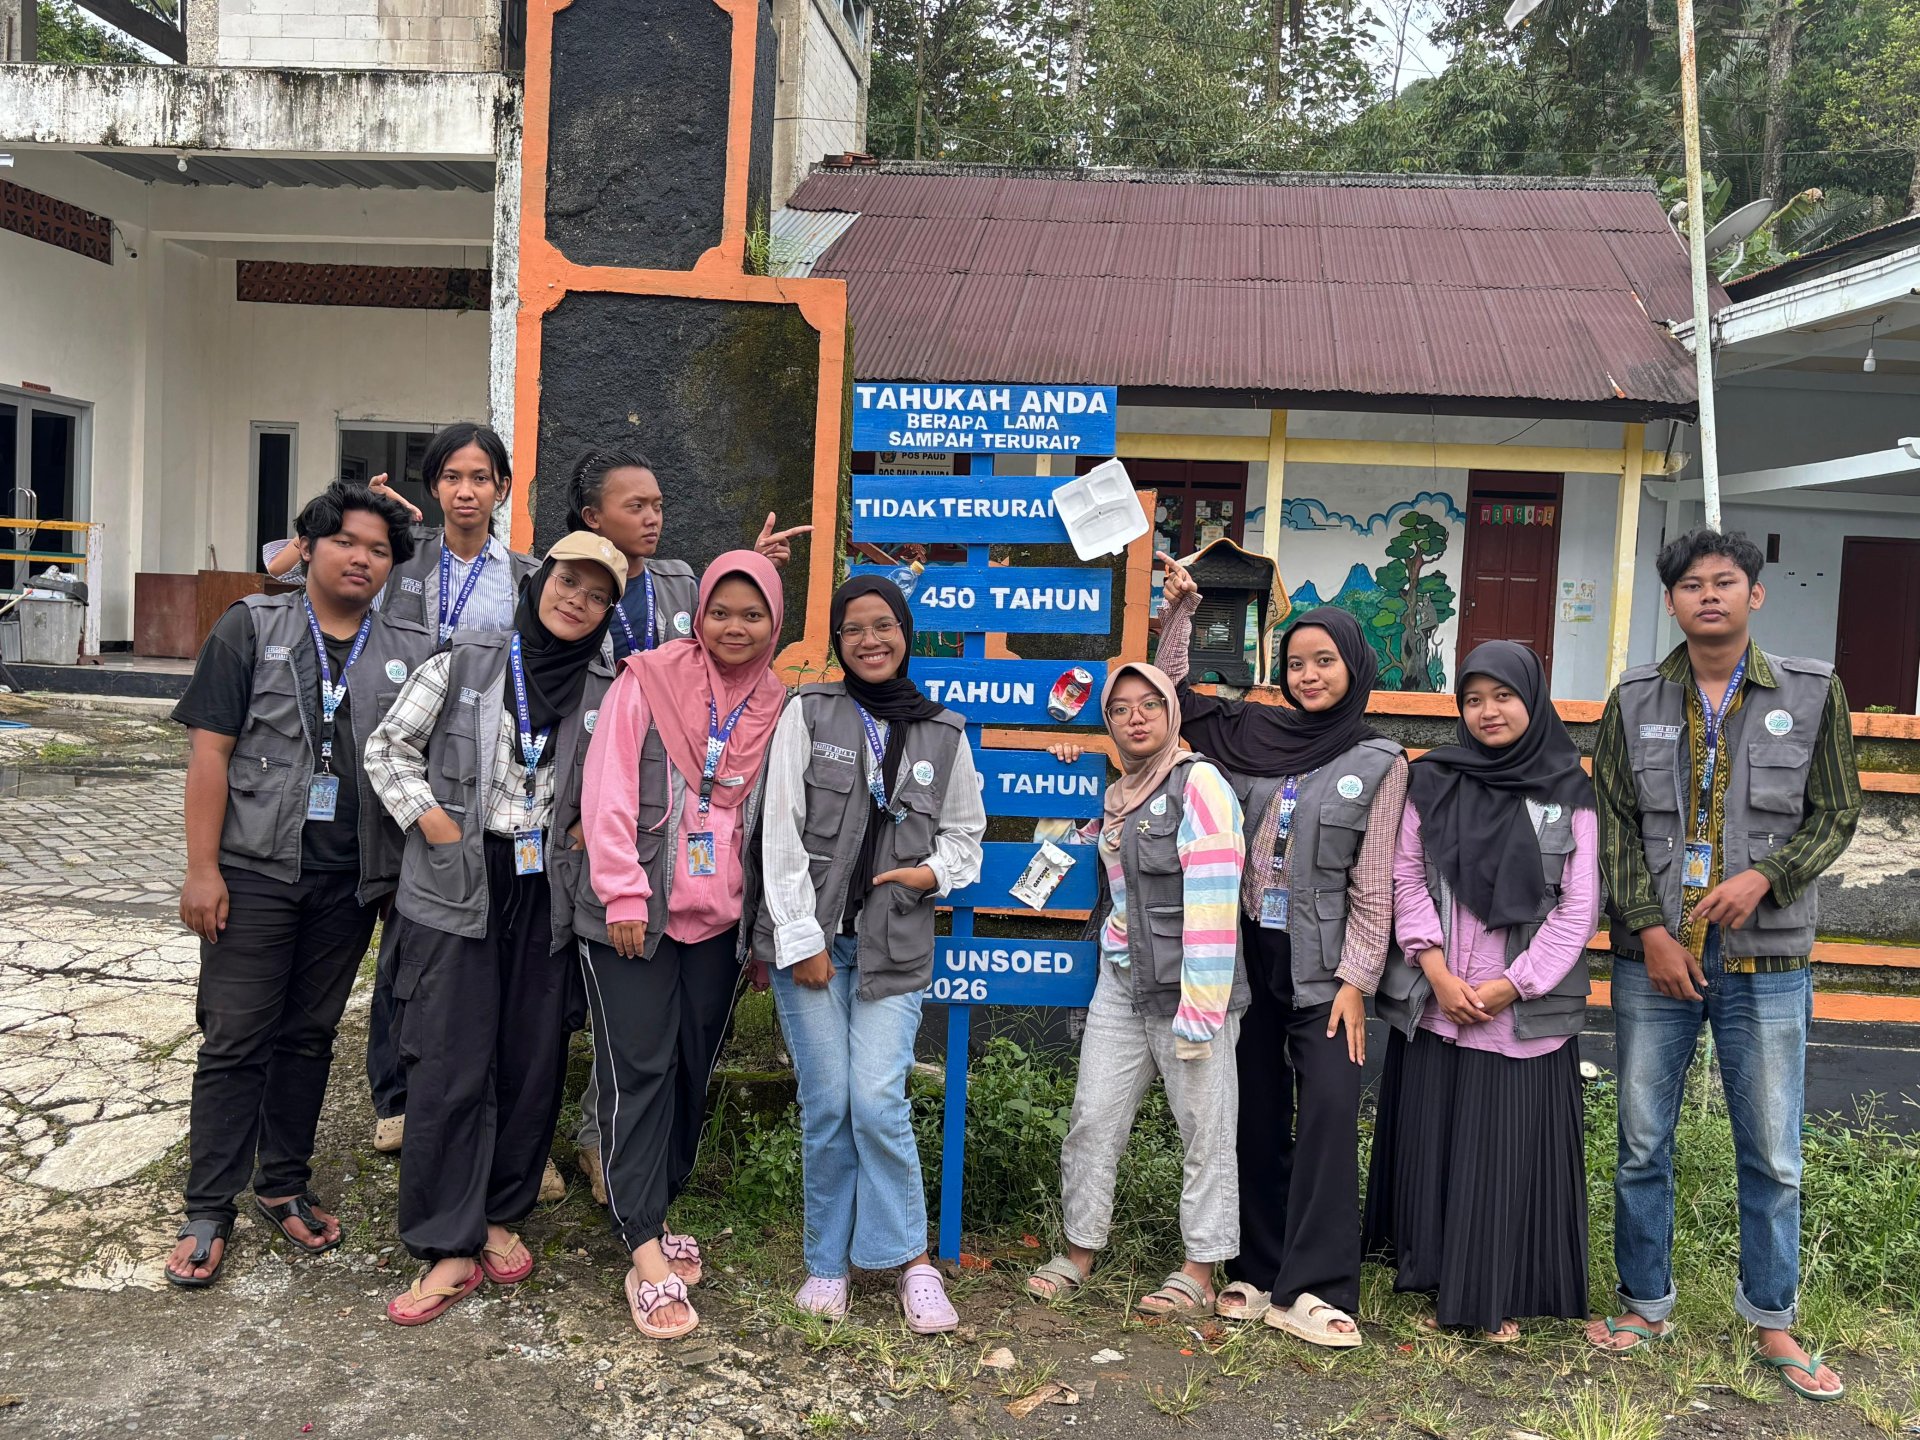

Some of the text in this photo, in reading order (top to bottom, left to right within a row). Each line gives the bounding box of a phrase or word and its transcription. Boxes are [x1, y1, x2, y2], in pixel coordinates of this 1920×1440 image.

[856, 386, 1107, 414] TAHUKAH ANDA
[907, 413, 1059, 430] BERAPA LAMA
[889, 432, 1080, 450] SAMPAH TERURAI?
[922, 452, 946, 460] PAUD
[855, 498, 1054, 517] TIDAK TERURAI
[1481, 507, 1552, 521] WELCOME
[454, 601, 464, 614] KKN
[920, 586, 1100, 612] 450 TAHUN
[924, 680, 1035, 705] TAHUN
[997, 773, 1099, 796] TAHUN
[945, 949, 1074, 974] UNSOED
